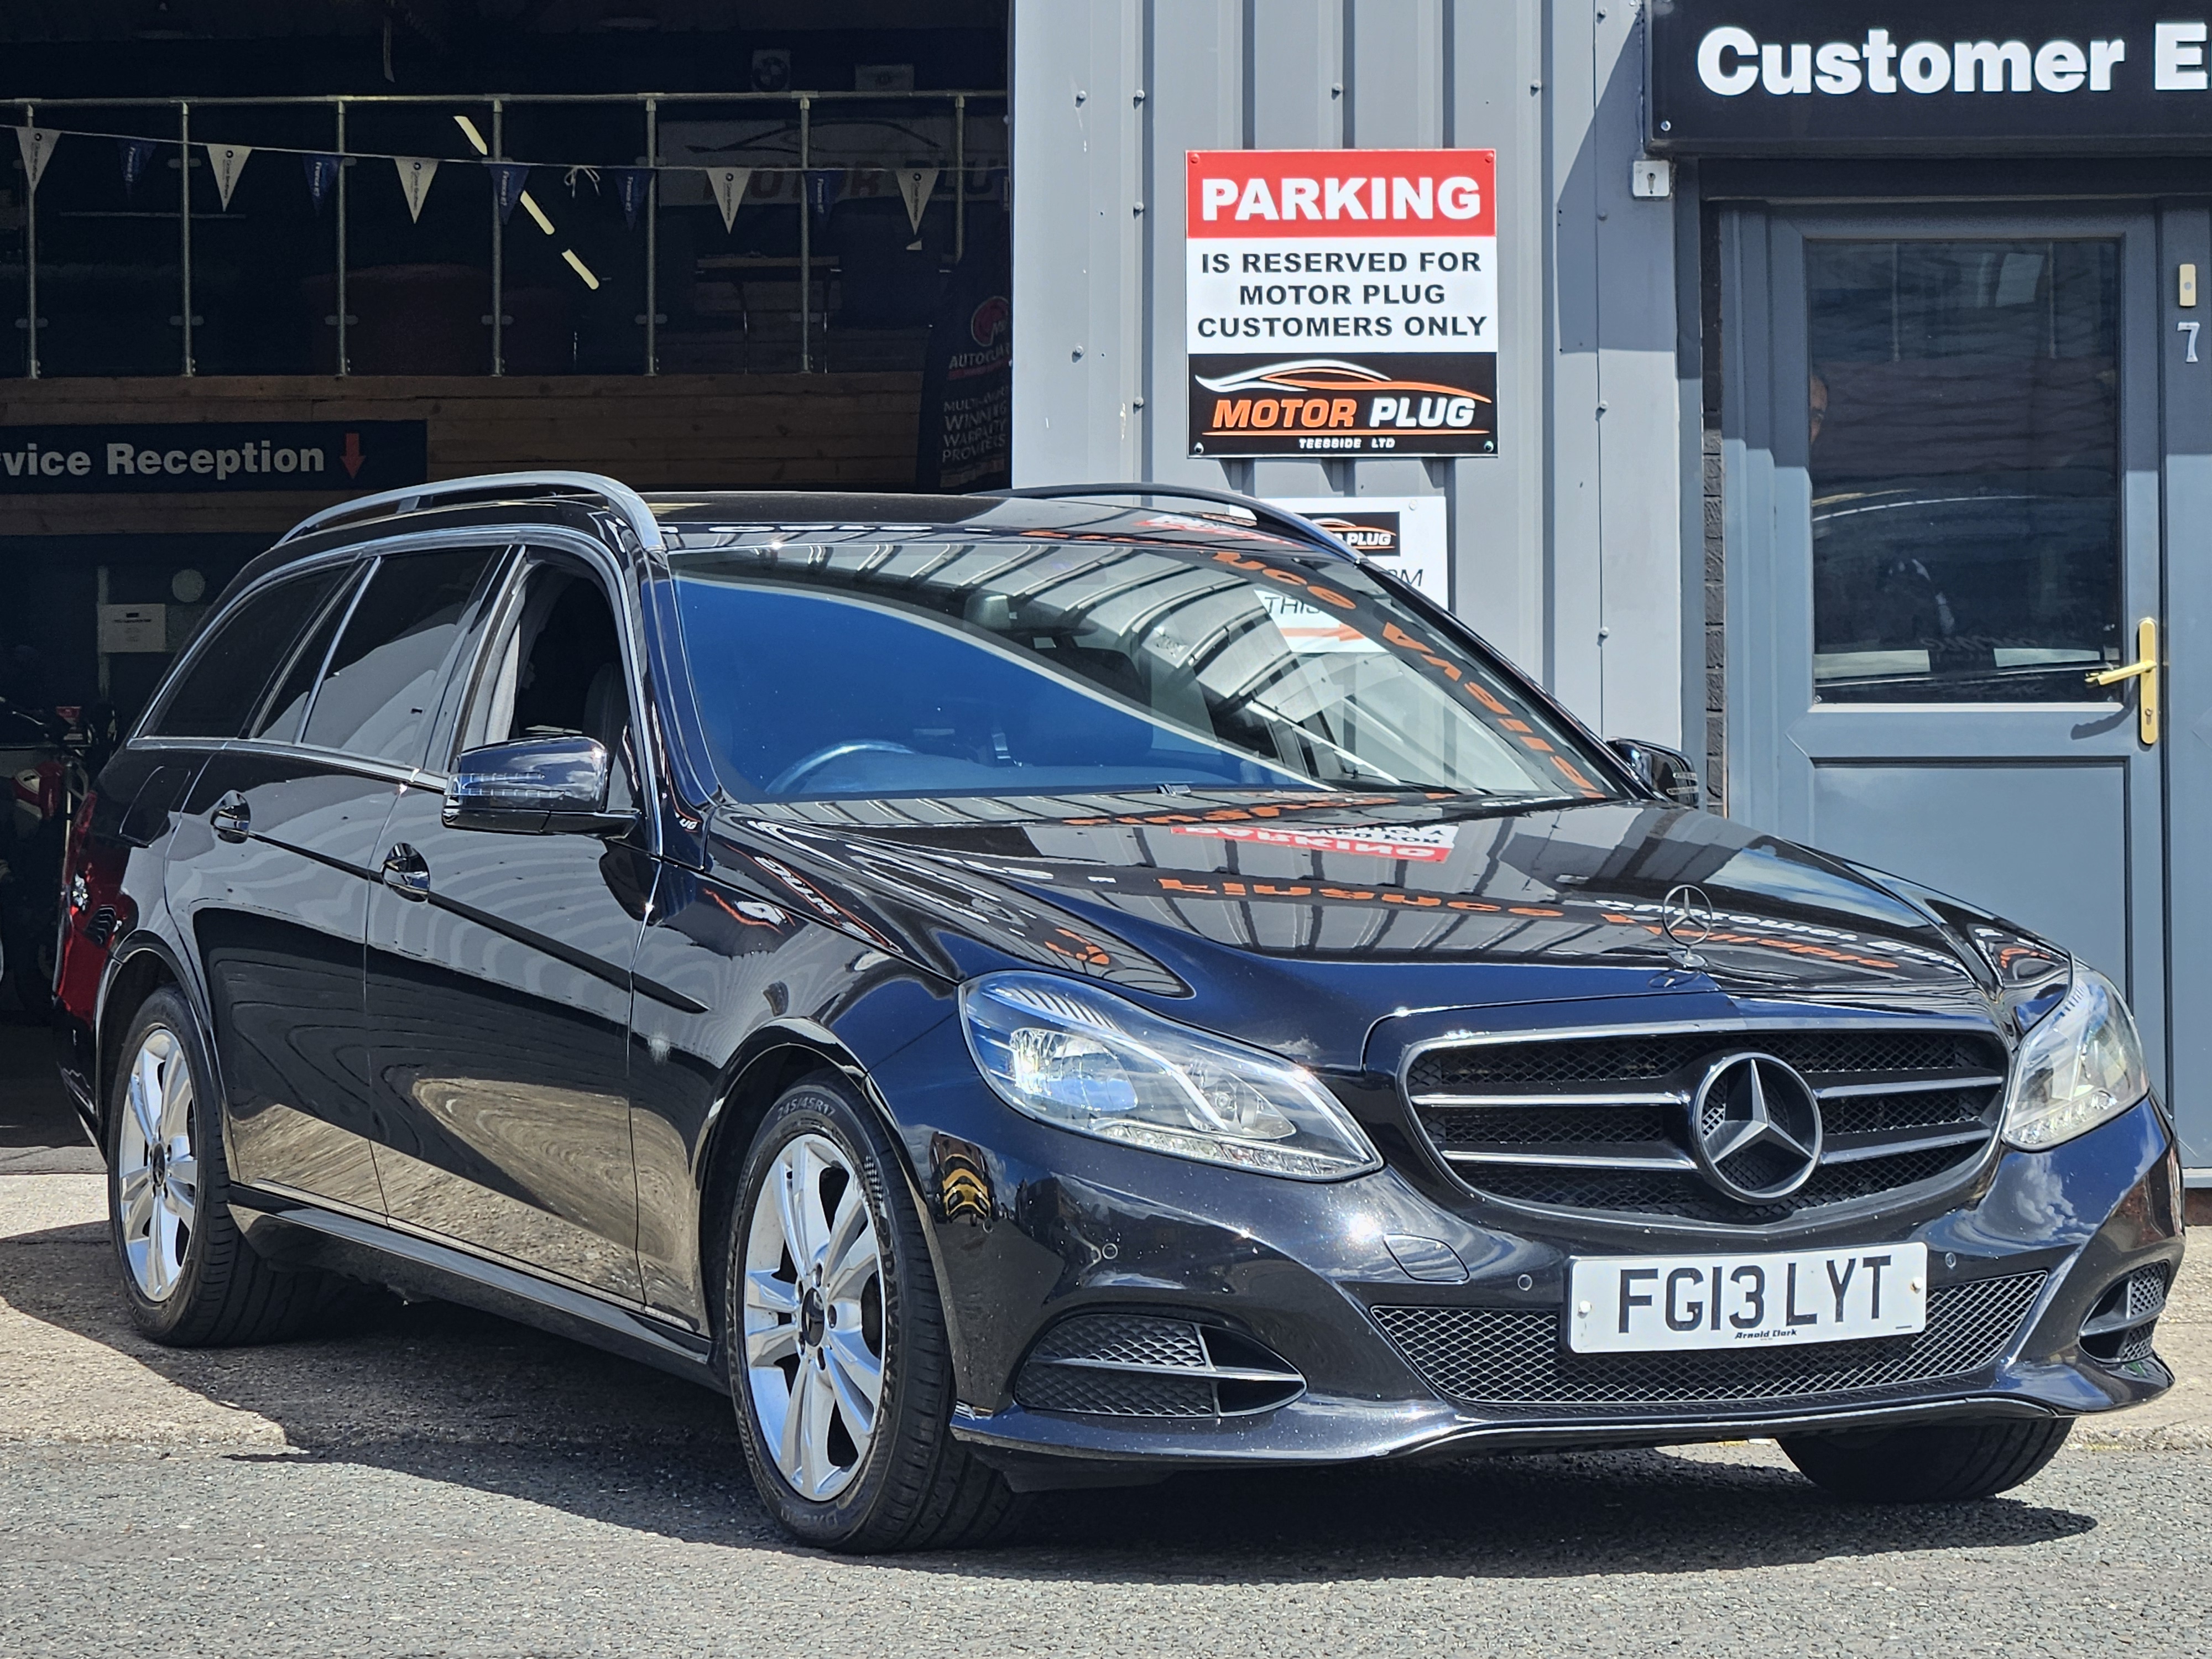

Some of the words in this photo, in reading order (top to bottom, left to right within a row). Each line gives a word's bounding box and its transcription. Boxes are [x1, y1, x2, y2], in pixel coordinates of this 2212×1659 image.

[1697, 27, 2125, 96] Customer
[2155, 22, 2212, 90] E
[1202, 176, 1480, 221] PARKING
[1202, 253, 1230, 273] IS
[1243, 252, 1407, 273] RESERVED
[1420, 252, 1481, 272] FOR
[1240, 285, 1352, 305] MOTOR
[1363, 284, 1445, 304] PLUG
[1197, 317, 1392, 337] CUSTOMERS
[1404, 316, 1487, 336] ONLY
[2177, 321, 2200, 363] 7
[1213, 399, 1357, 428] MOTOR
[1369, 398, 1475, 427] PLUG
[1299, 438, 1361, 448] TEESSIDE
[1371, 438, 1395, 448] LTD
[0, 443, 92, 476] vice
[107, 440, 325, 480] Reception
[1347, 533, 1391, 546] PLUG
[1619, 1265, 1765, 1334] FG13
[1786, 1255, 1892, 1326] LYT
[1734, 1331, 1770, 1339] Arnold
[1772, 1329, 1797, 1337] Clark
